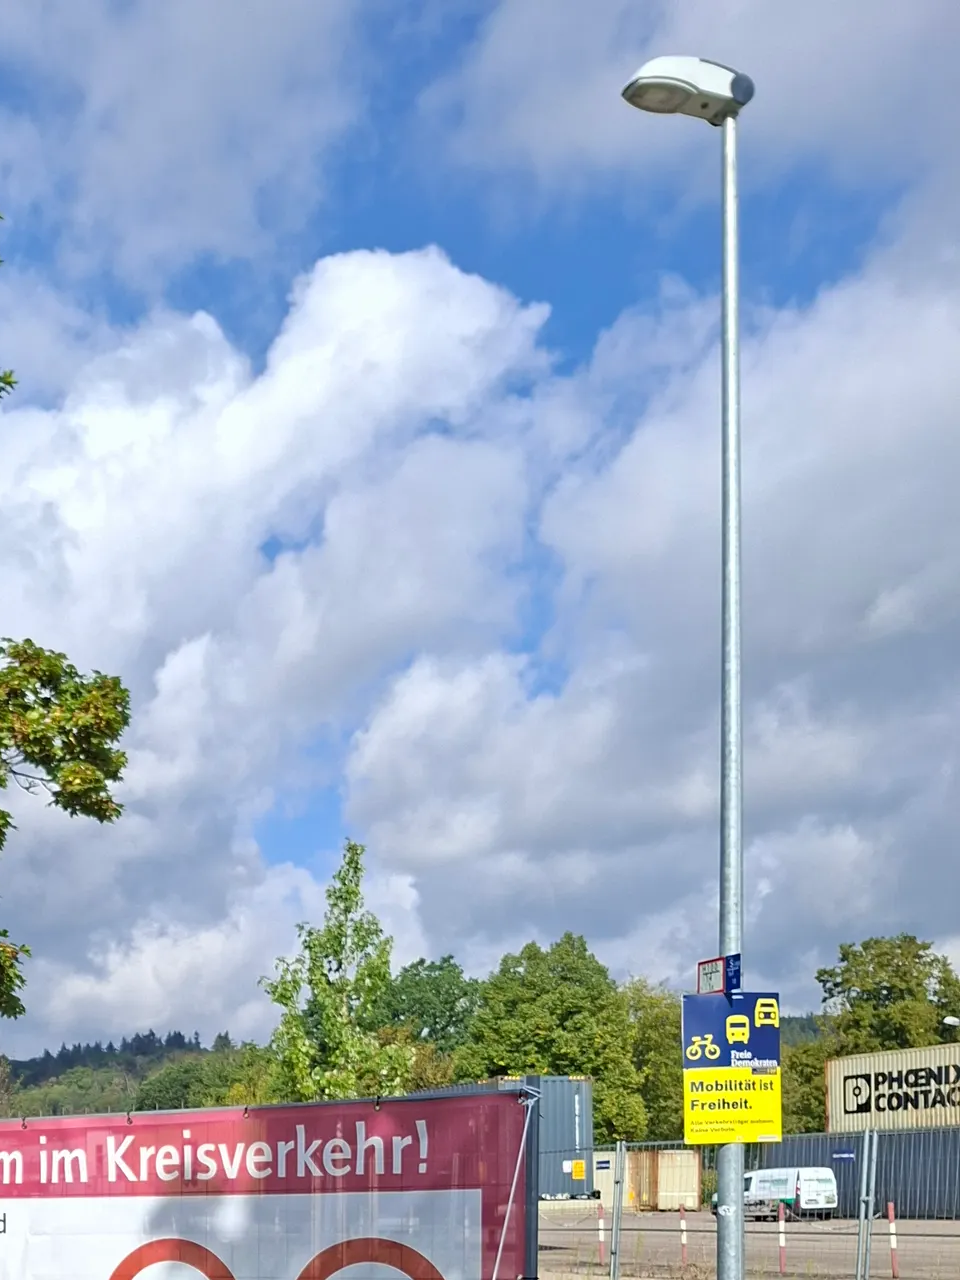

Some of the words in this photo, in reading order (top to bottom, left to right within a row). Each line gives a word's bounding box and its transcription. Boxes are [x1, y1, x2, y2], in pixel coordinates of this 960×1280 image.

[730, 1050, 752, 1059] Freie
[730, 1058, 778, 1068] Demokraten
[690, 1080, 757, 1093] Mobilität
[759, 1080, 774, 1091] ist
[690, 1098, 752, 1111] Freiheit.
[39, 1135, 88, 1185] im
[106, 1119, 429, 1182] Kreisverkehr!
